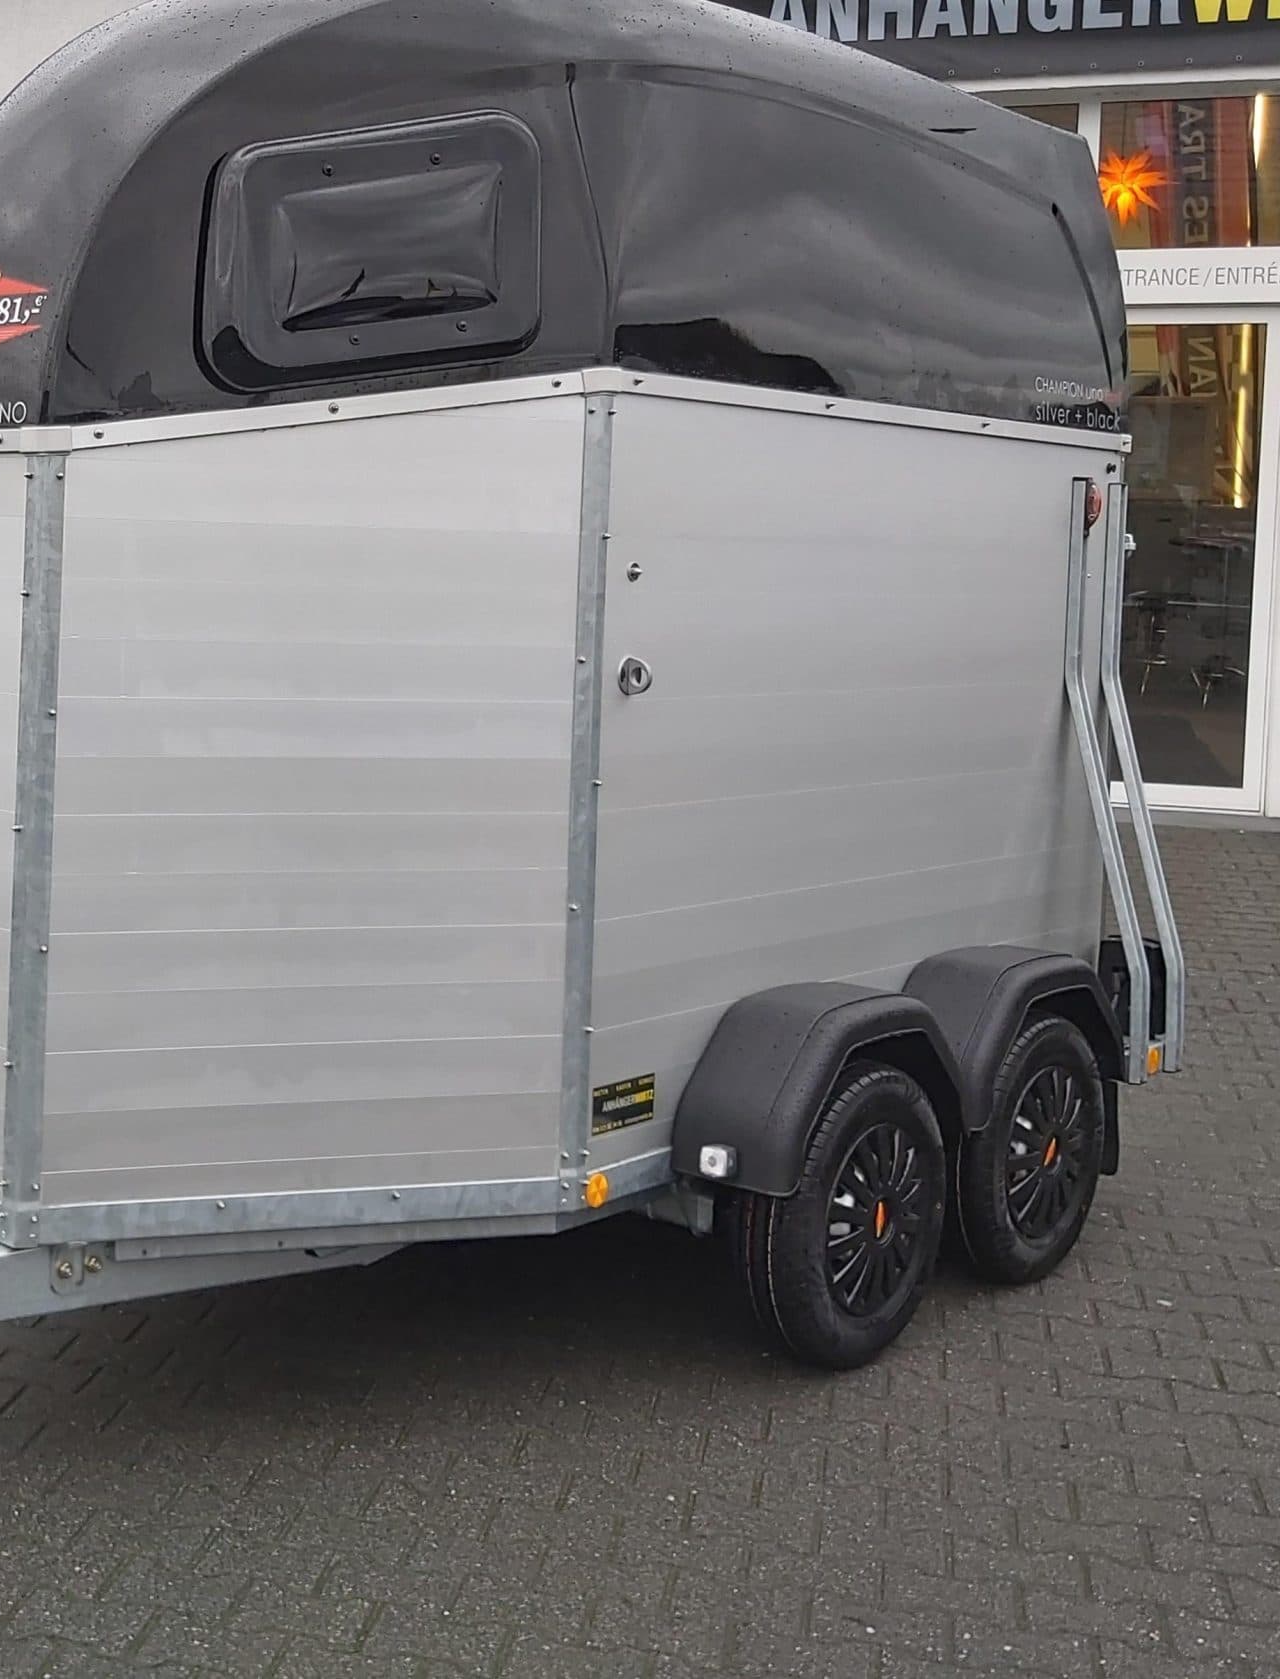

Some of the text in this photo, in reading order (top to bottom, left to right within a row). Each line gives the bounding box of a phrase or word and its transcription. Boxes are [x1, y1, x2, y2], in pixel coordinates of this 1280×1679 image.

[1119, 267, 1200, 287] TRANCE
[1035, 376, 1104, 402] CHAMPION uno
[1036, 401, 1071, 424] silver
[1086, 406, 1121, 431] black
